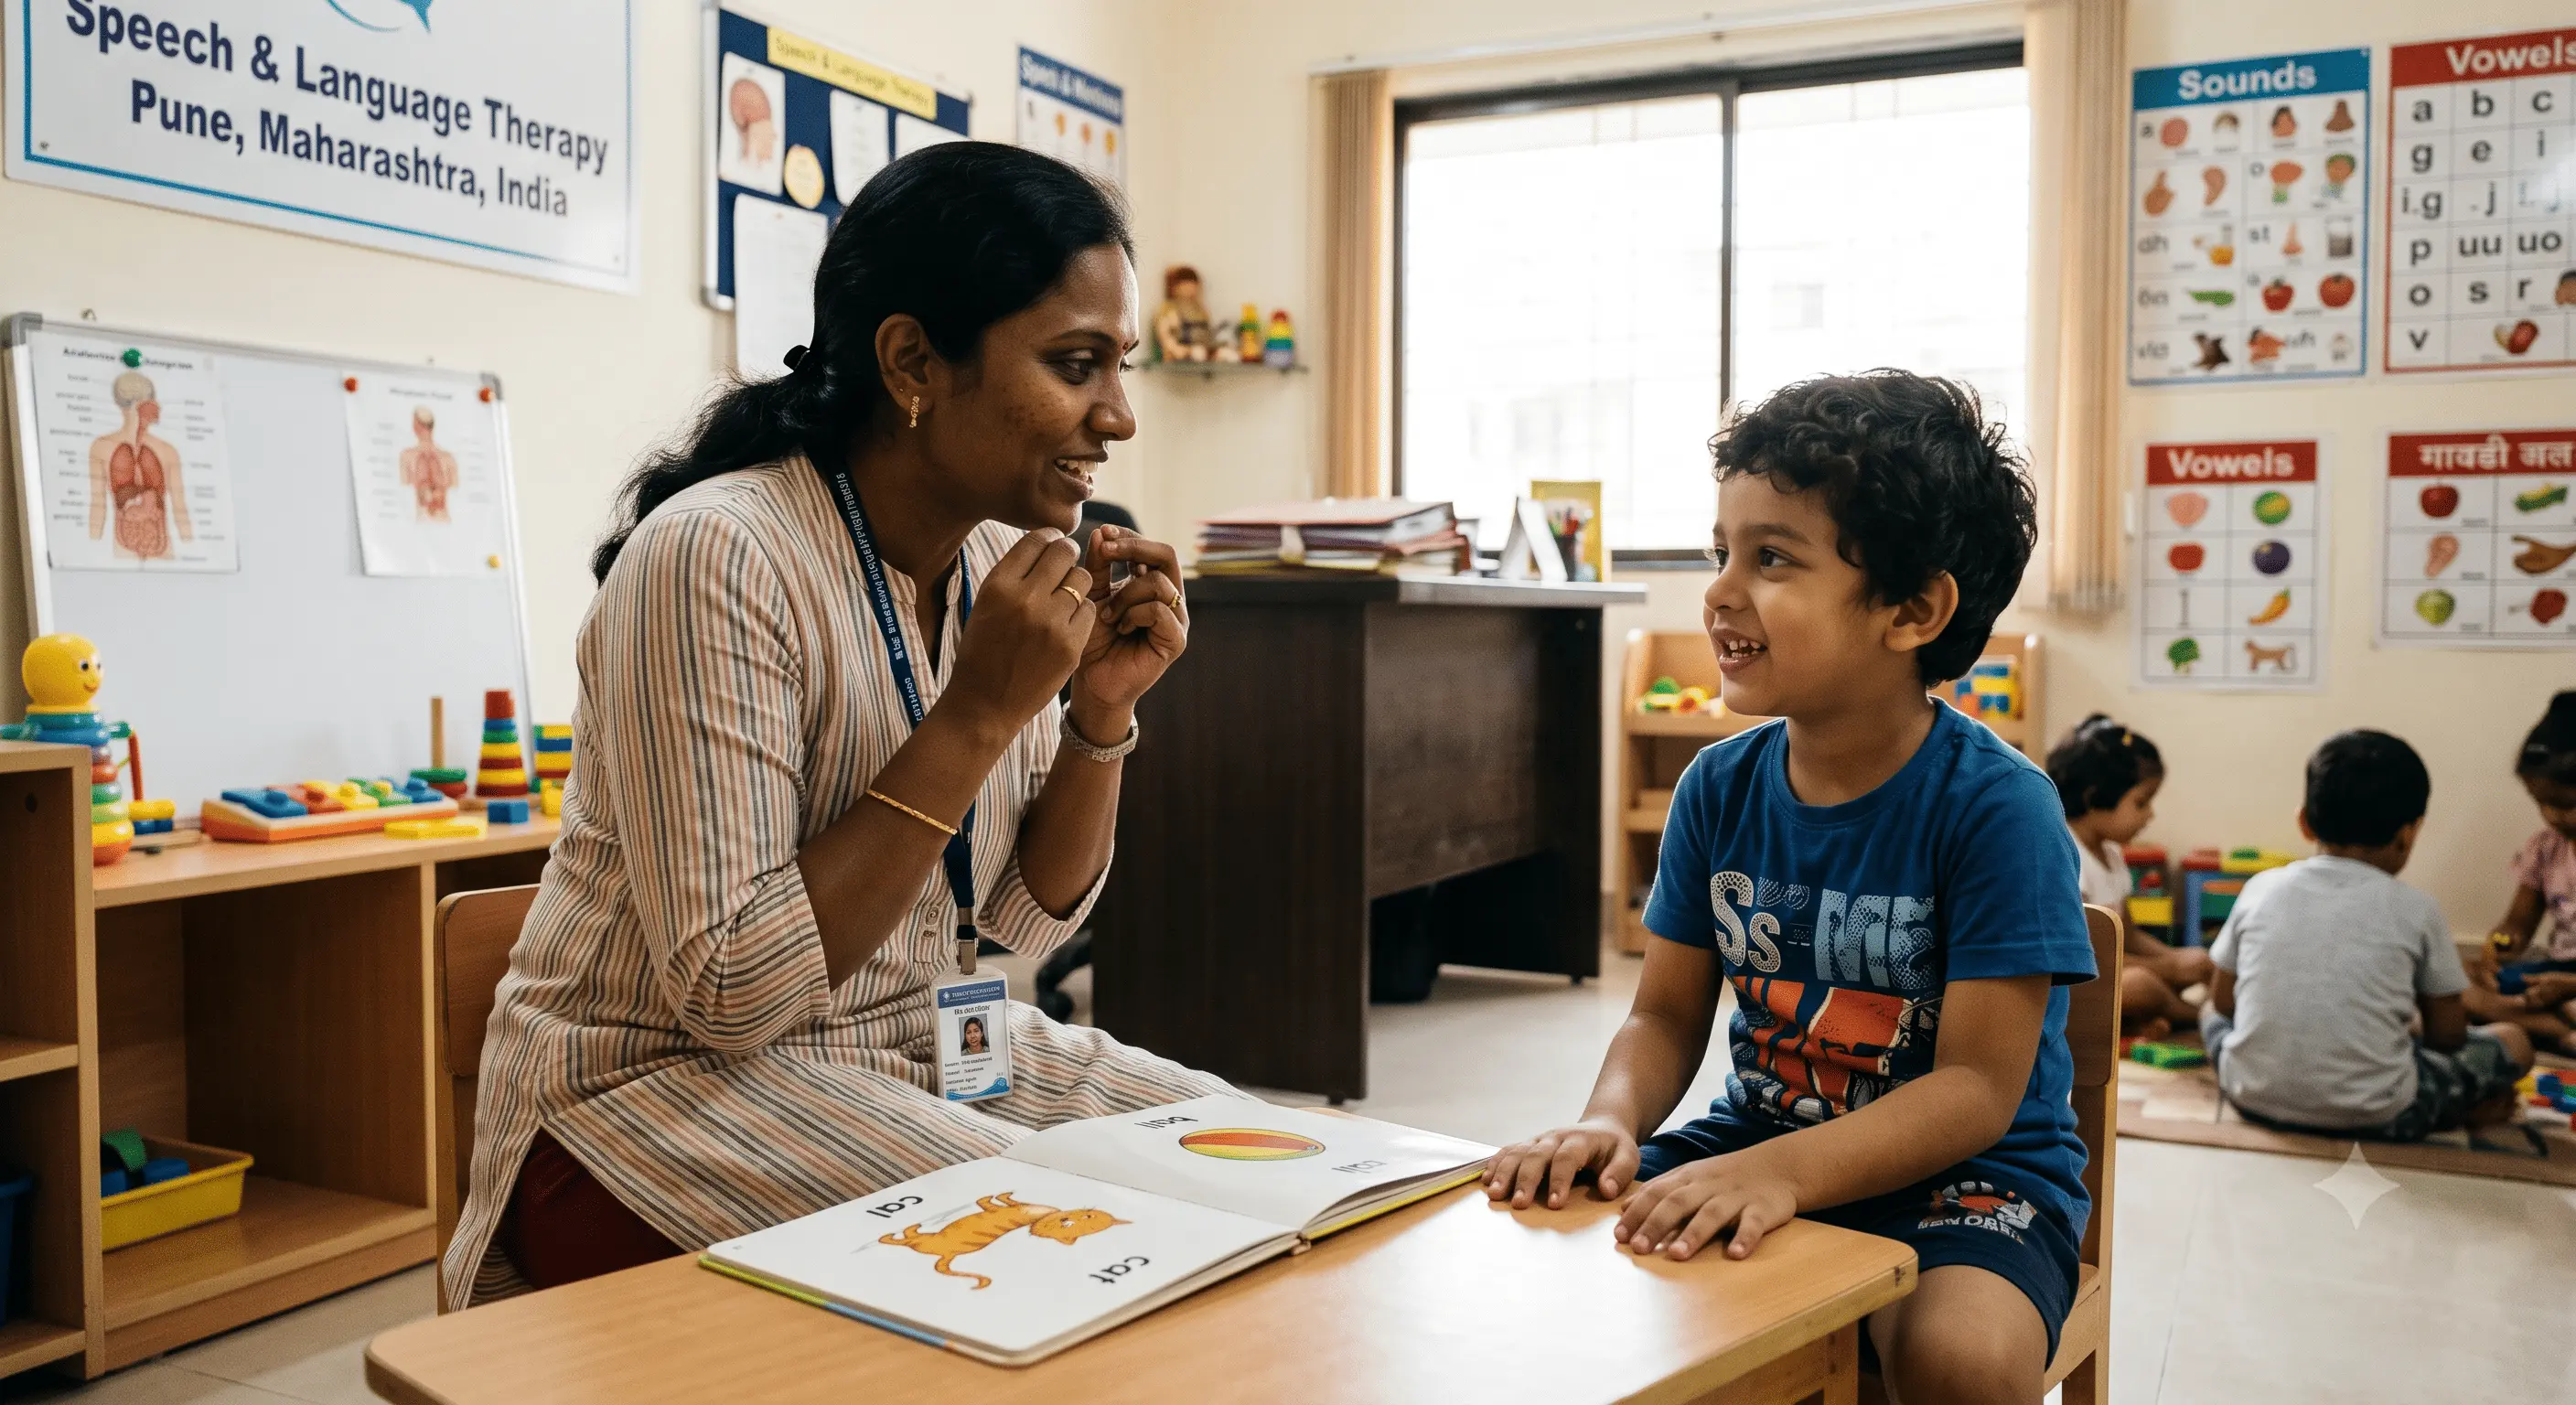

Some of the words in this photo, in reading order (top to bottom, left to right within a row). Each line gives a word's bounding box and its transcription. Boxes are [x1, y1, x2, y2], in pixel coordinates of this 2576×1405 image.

[2445, 36, 2576, 75] Vowels
[66, 0, 232, 72] Speech
[251, 34, 279, 83] &
[295, 45, 471, 136] Language
[484, 97, 608, 176] Therapy
[2178, 59, 2317, 101] Sounds
[2411, 99, 2433, 123] a
[2471, 89, 2495, 118] b
[2531, 90, 2553, 113] c
[132, 78, 244, 156] Pune,
[259, 109, 486, 208] Maharashtra,
[498, 166, 568, 217] India
[2410, 143, 2434, 174] g
[2470, 139, 2494, 163] e
[2410, 237, 2432, 266] p
[2458, 232, 2502, 257] uu
[2517, 230, 2562, 254] uo
[2408, 283, 2431, 306] o
[2468, 280, 2489, 304] s
[2517, 278, 2531, 300] r
[2408, 327, 2430, 350] v
[2167, 446, 2295, 479] Vowels
[1088, 1256, 1150, 1284] cat
